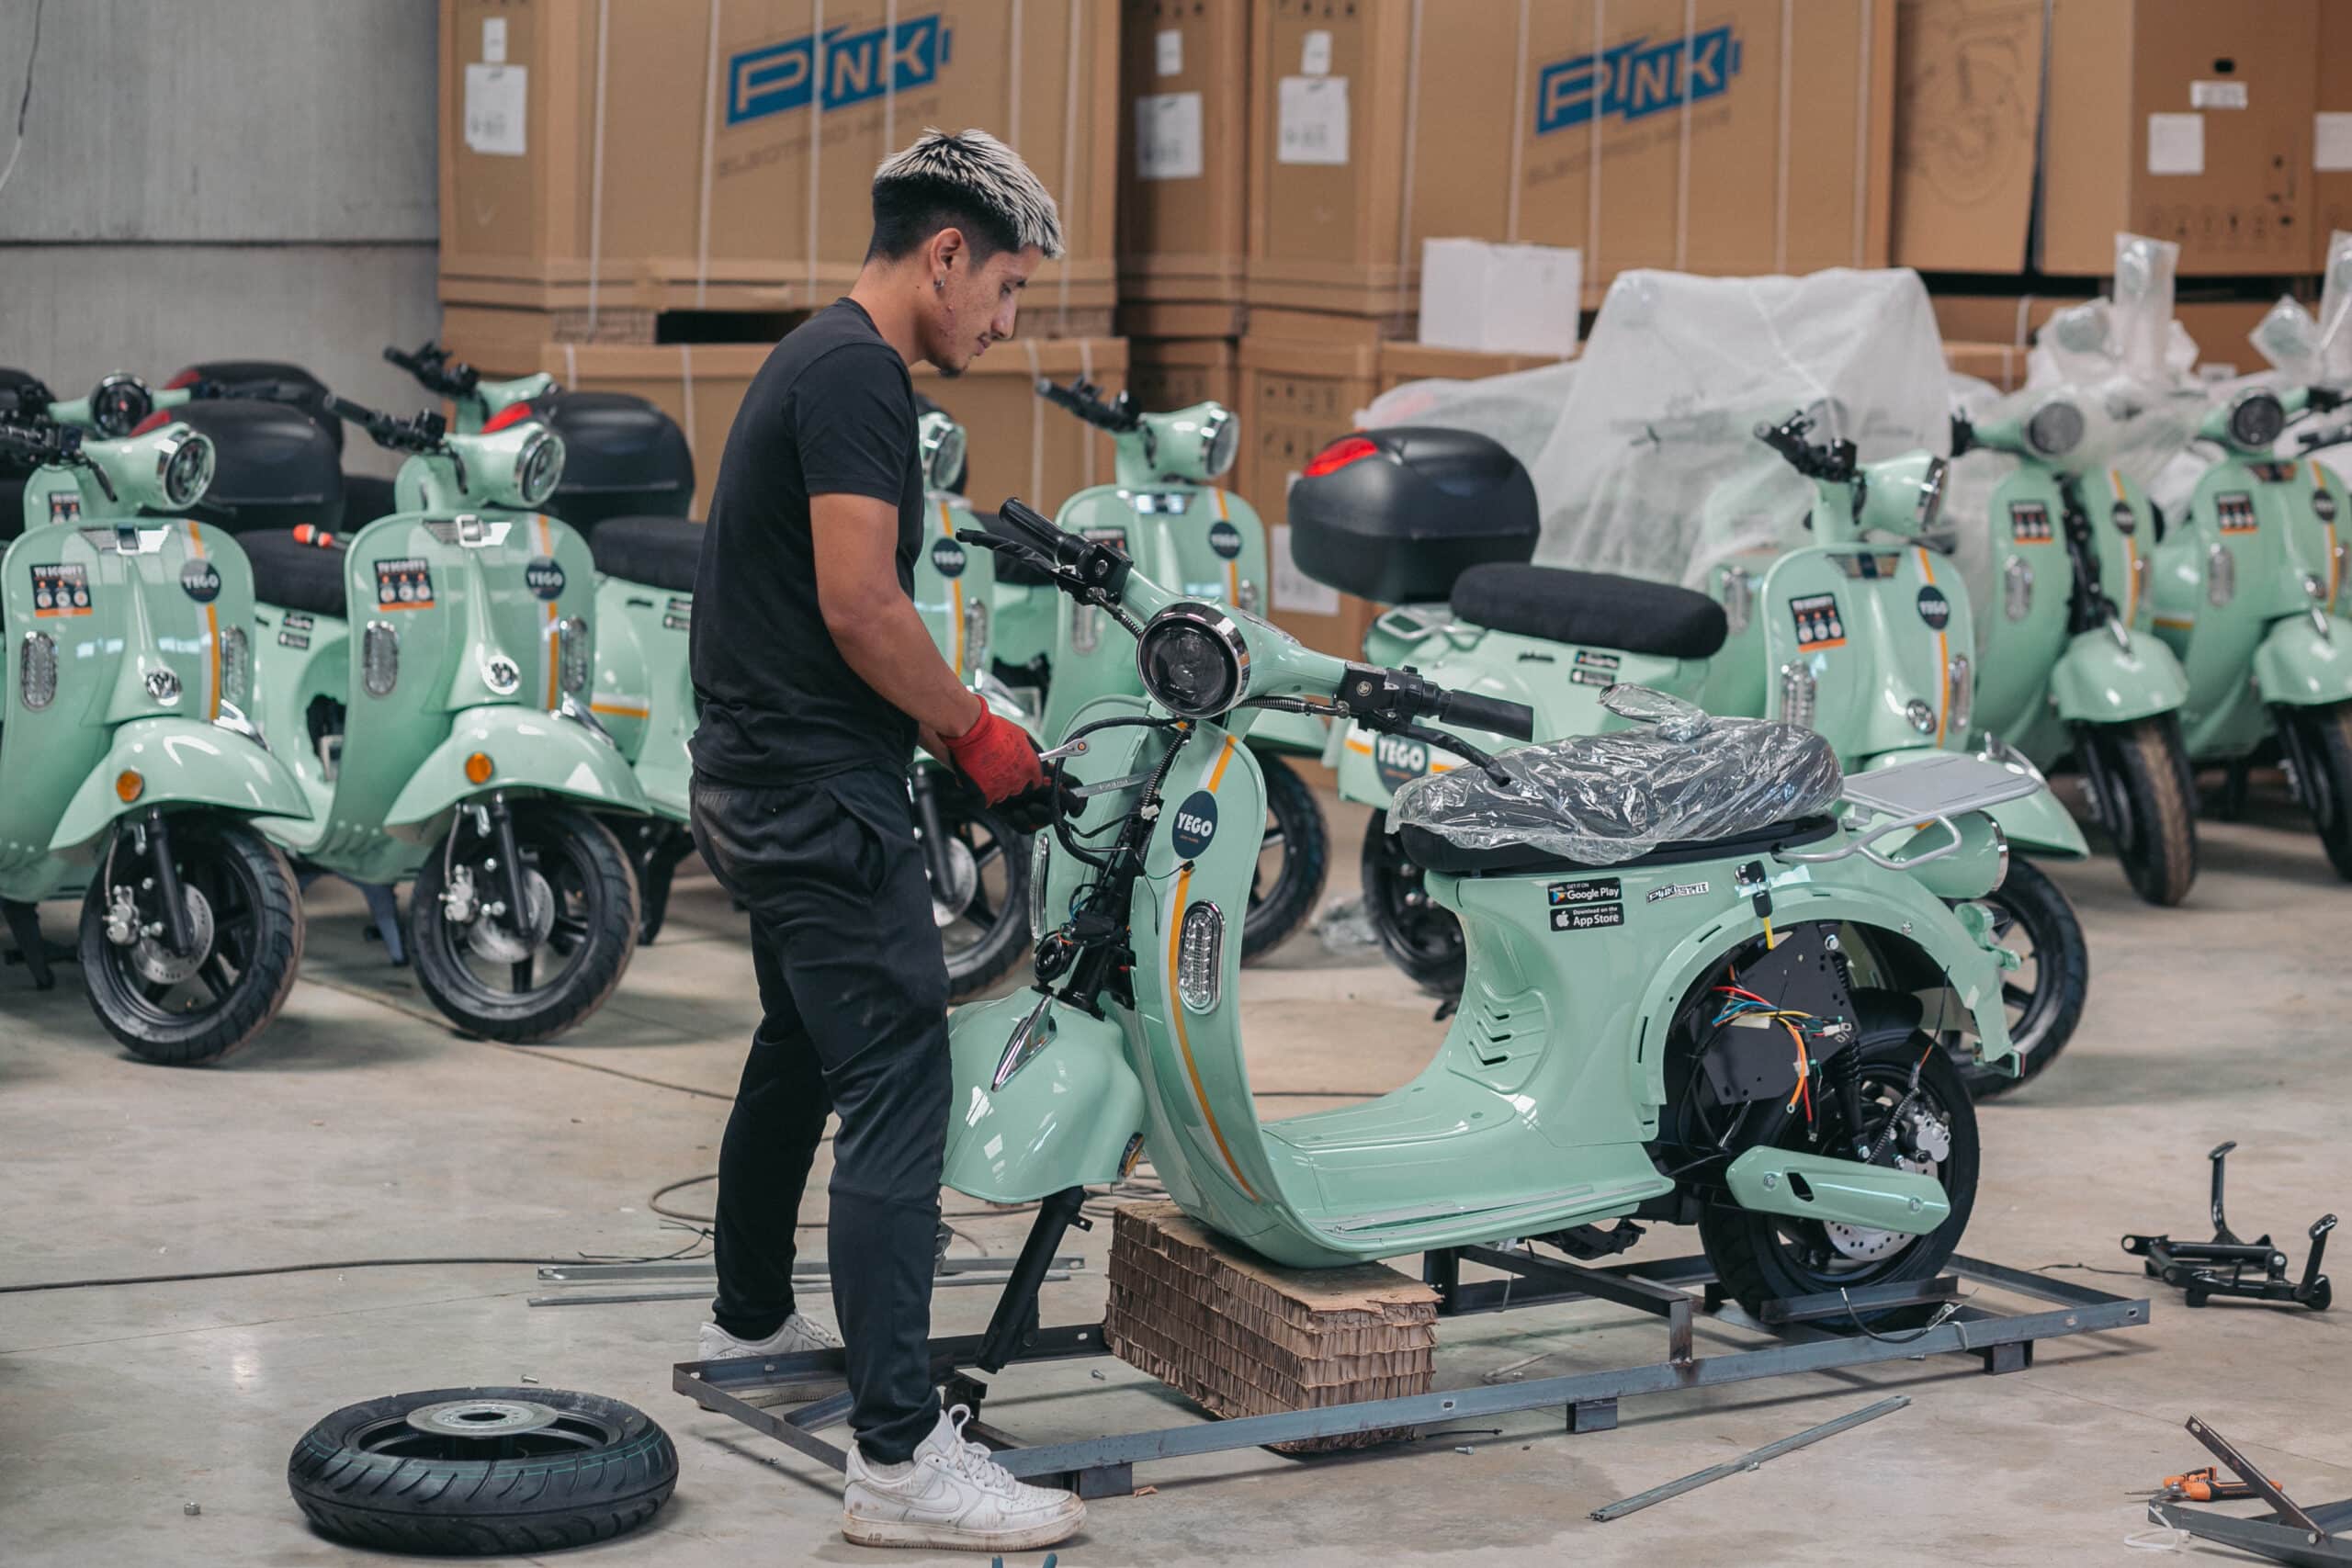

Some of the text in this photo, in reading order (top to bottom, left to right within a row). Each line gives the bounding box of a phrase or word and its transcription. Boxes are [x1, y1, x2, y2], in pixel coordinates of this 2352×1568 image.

[737, 27, 930, 113] PINK
[1544, 39, 1721, 122] PINK
[1378, 738, 1425, 772] YEGO
[1177, 812, 1213, 837] YEGO
[1566, 887, 1619, 900] Google Play
[1573, 914, 1619, 927] App Store
